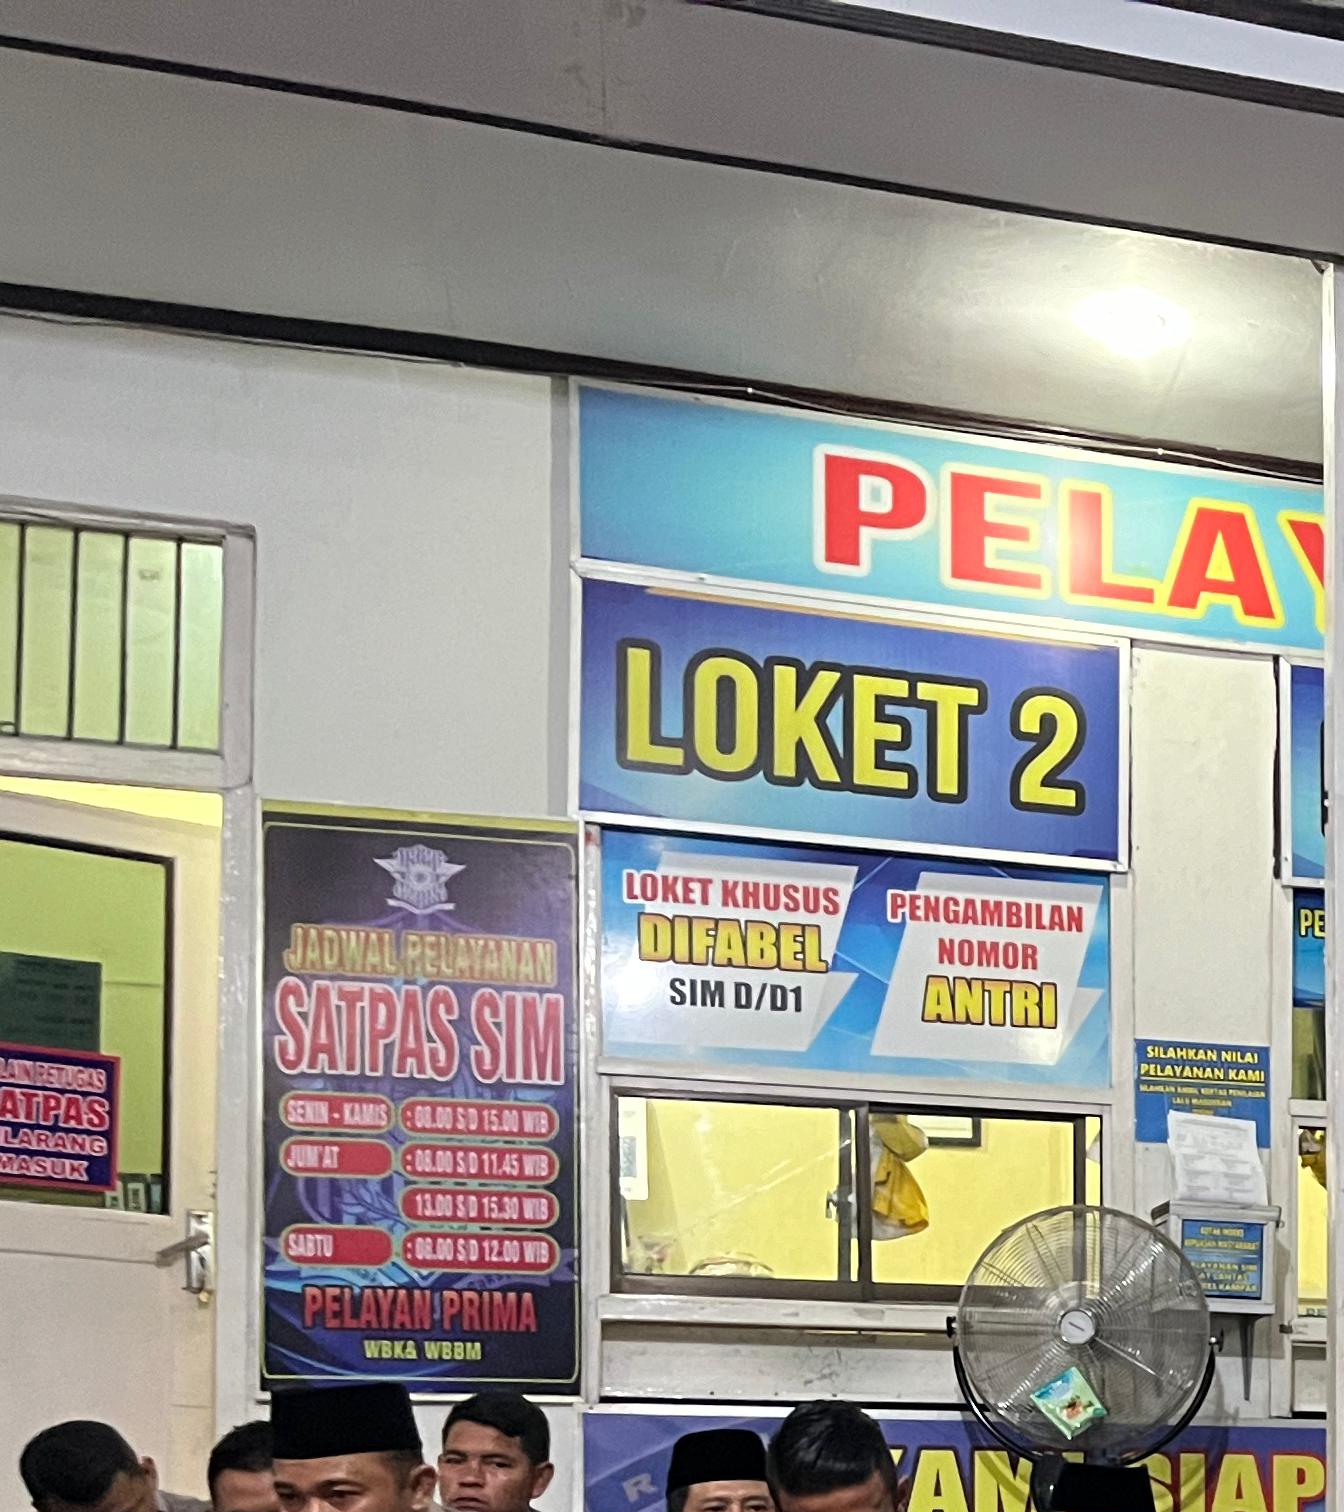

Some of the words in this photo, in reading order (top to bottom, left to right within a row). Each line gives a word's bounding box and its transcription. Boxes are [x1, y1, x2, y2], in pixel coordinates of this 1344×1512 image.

[616, 638, 987, 804] LOKET
[1010, 686, 1087, 815] 2
[623, 870, 715, 906] LOKET
[721, 879, 841, 916] KHUSUS
[888, 891, 1085, 933] PENGAMBILAN
[285, 925, 397, 974] JADWAL
[404, 932, 555, 986] PELAYANAN
[638, 912, 829, 973] DIFABEL
[937, 938, 1039, 971] NOMOR
[669, 977, 725, 1009] SIM
[734, 982, 803, 1013] D/D1
[921, 975, 1059, 1029] ANTRI
[275, 977, 459, 1081] SATPAS
[470, 988, 565, 1085] SIM
[1146, 1045, 1218, 1061] SILAHKAN
[1221, 1050, 1258, 1063] NILAI
[1140, 1063, 1225, 1080] PELAYANAN
[1228, 1068, 1265, 1082] KAMI
[522, 1110, 549, 1134] WIB
[482, 1153, 519, 1176] 11.45
[522, 1154, 549, 1178] WIB
[522, 1198, 549, 1222] WIB
[522, 1242, 550, 1265] WIB
[303, 1287, 432, 1330] PELAYAN
[442, 1290, 538, 1333] PRIMA
[424, 1341, 482, 1361] WBBM
